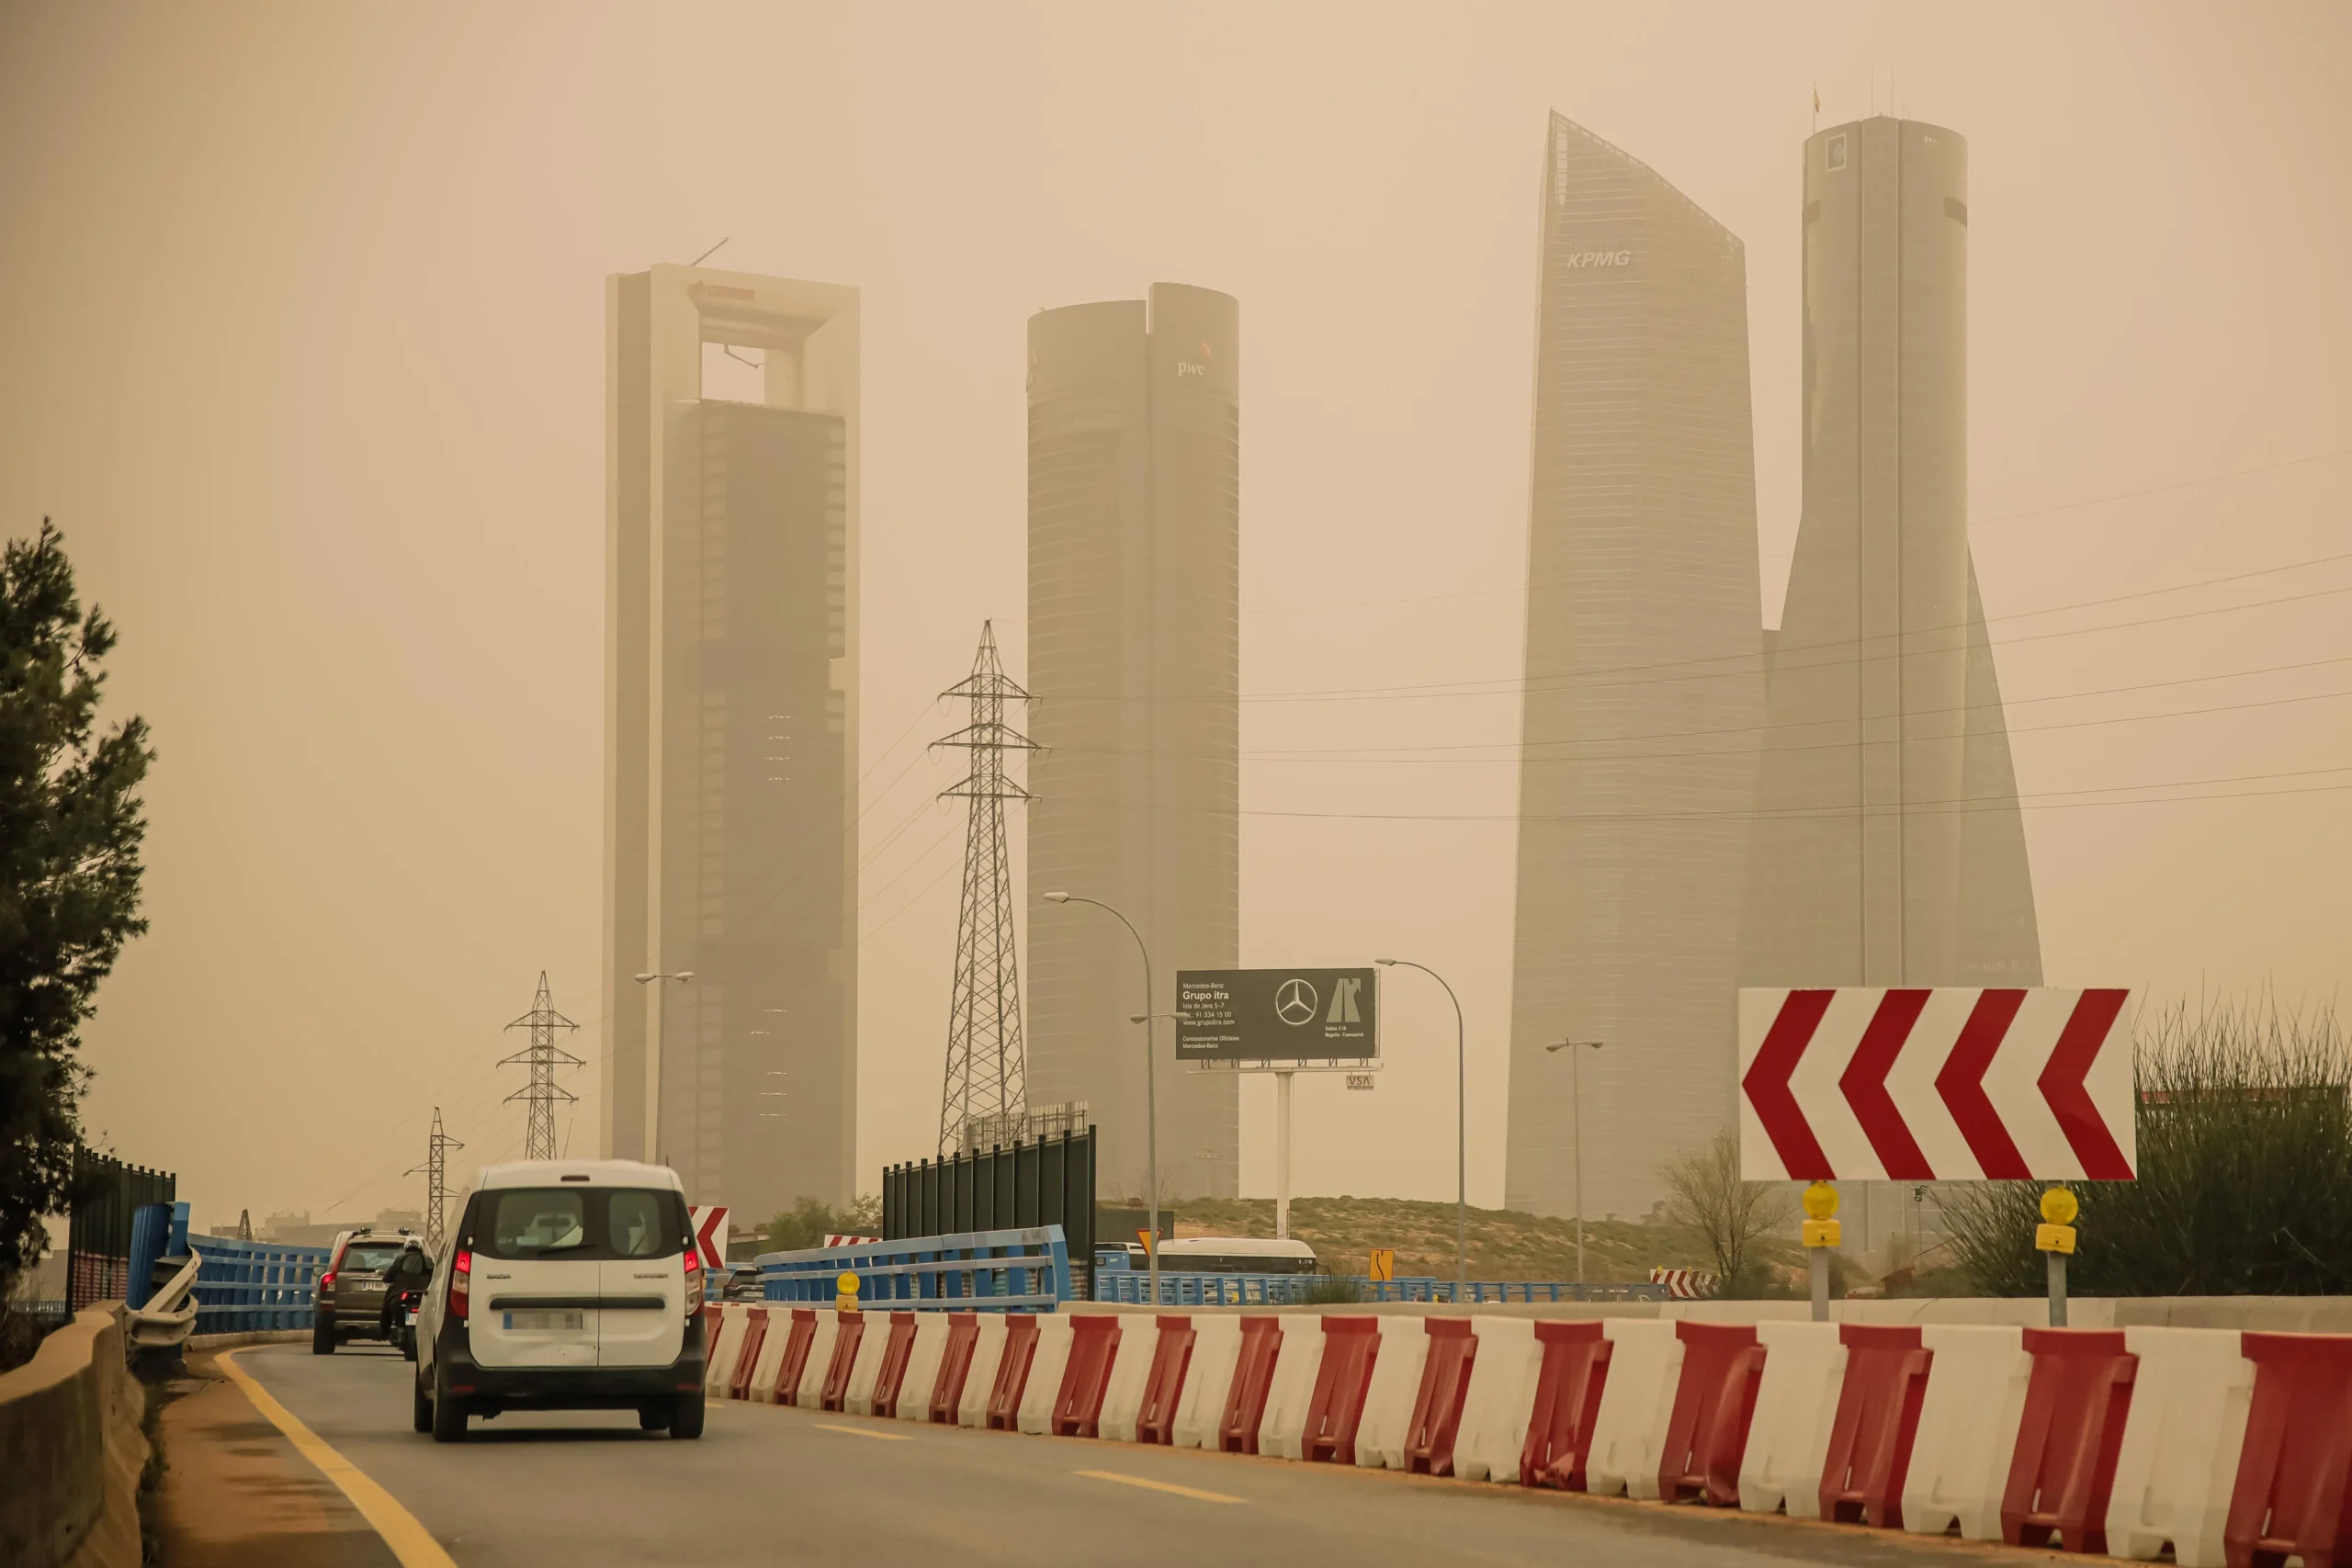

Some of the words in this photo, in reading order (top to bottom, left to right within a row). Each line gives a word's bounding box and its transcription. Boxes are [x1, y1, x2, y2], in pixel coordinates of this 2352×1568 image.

[1567, 250, 1631, 268] KPMG
[1177, 362, 1204, 377] pwc
[1182, 991, 1212, 1001] Grupo
[1214, 990, 1229, 999] itra
[1182, 1019, 1236, 1027] www.grupoitra.com
[1348, 1076, 1371, 1086] VSA
